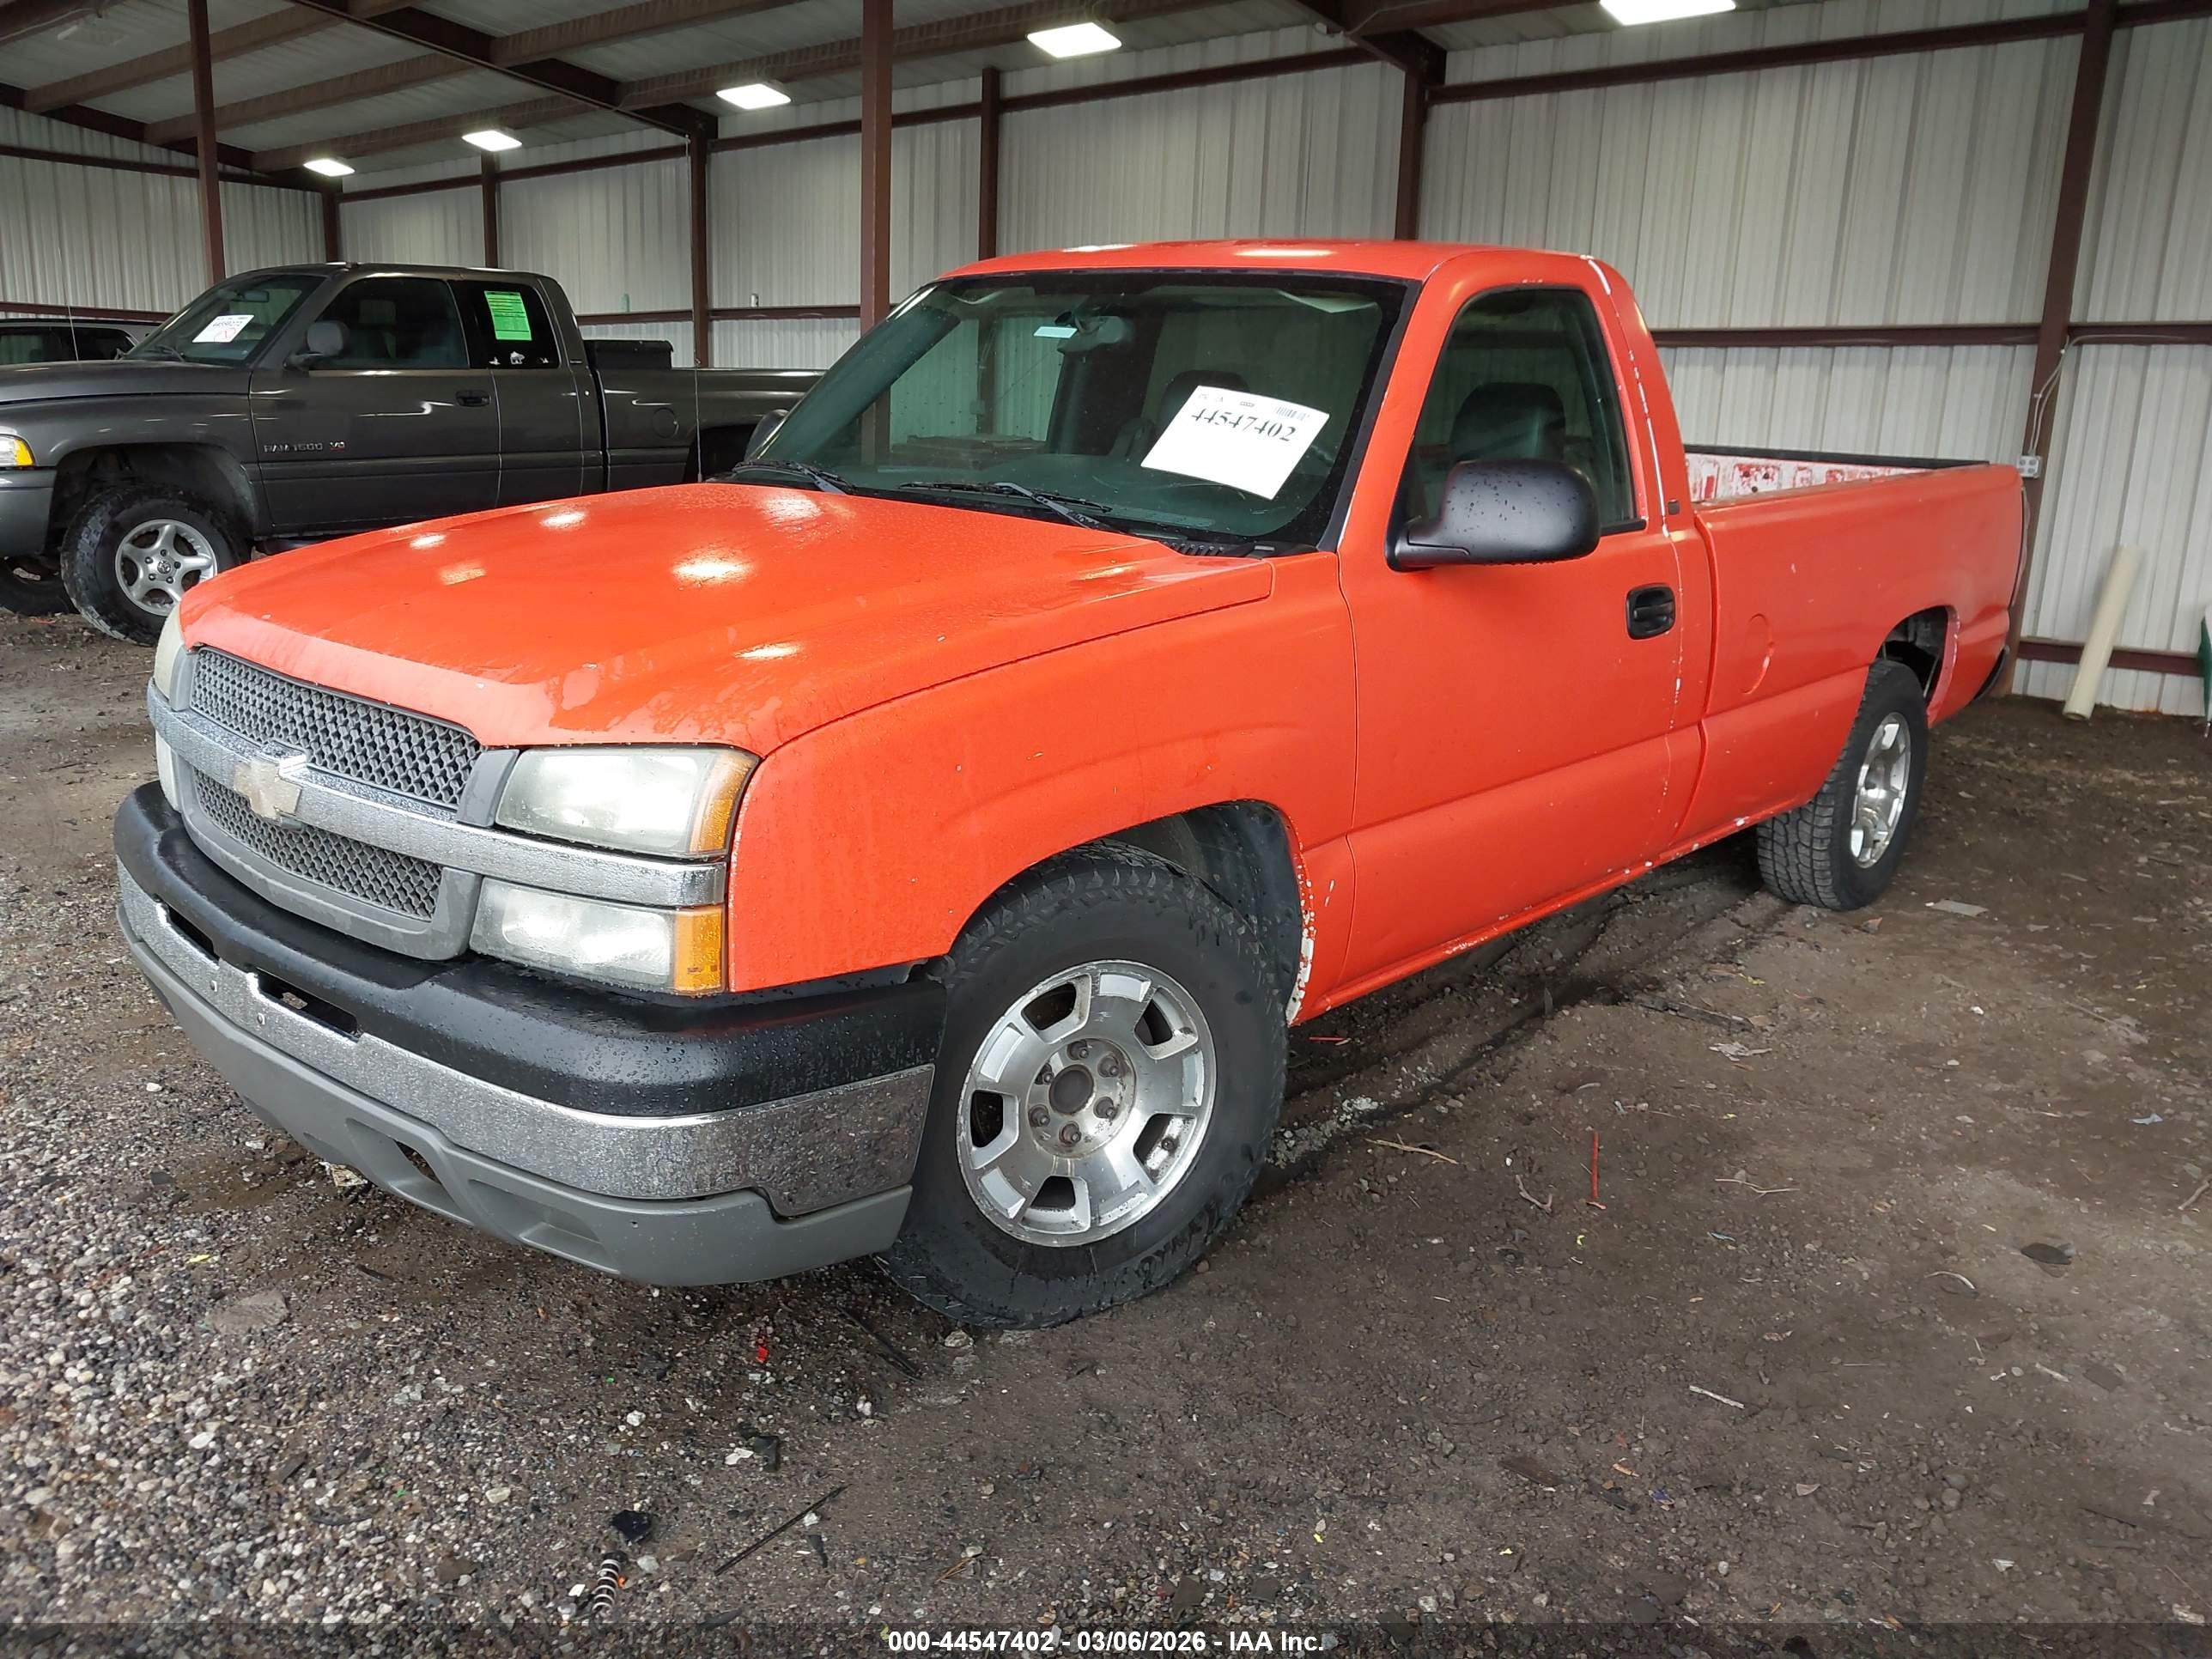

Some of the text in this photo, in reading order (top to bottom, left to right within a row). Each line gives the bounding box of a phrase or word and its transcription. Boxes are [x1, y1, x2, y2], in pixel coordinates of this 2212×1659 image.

[1191, 407, 1297, 442] 44547402
[264, 444, 290, 453] RAM
[293, 442, 324, 452] 1500
